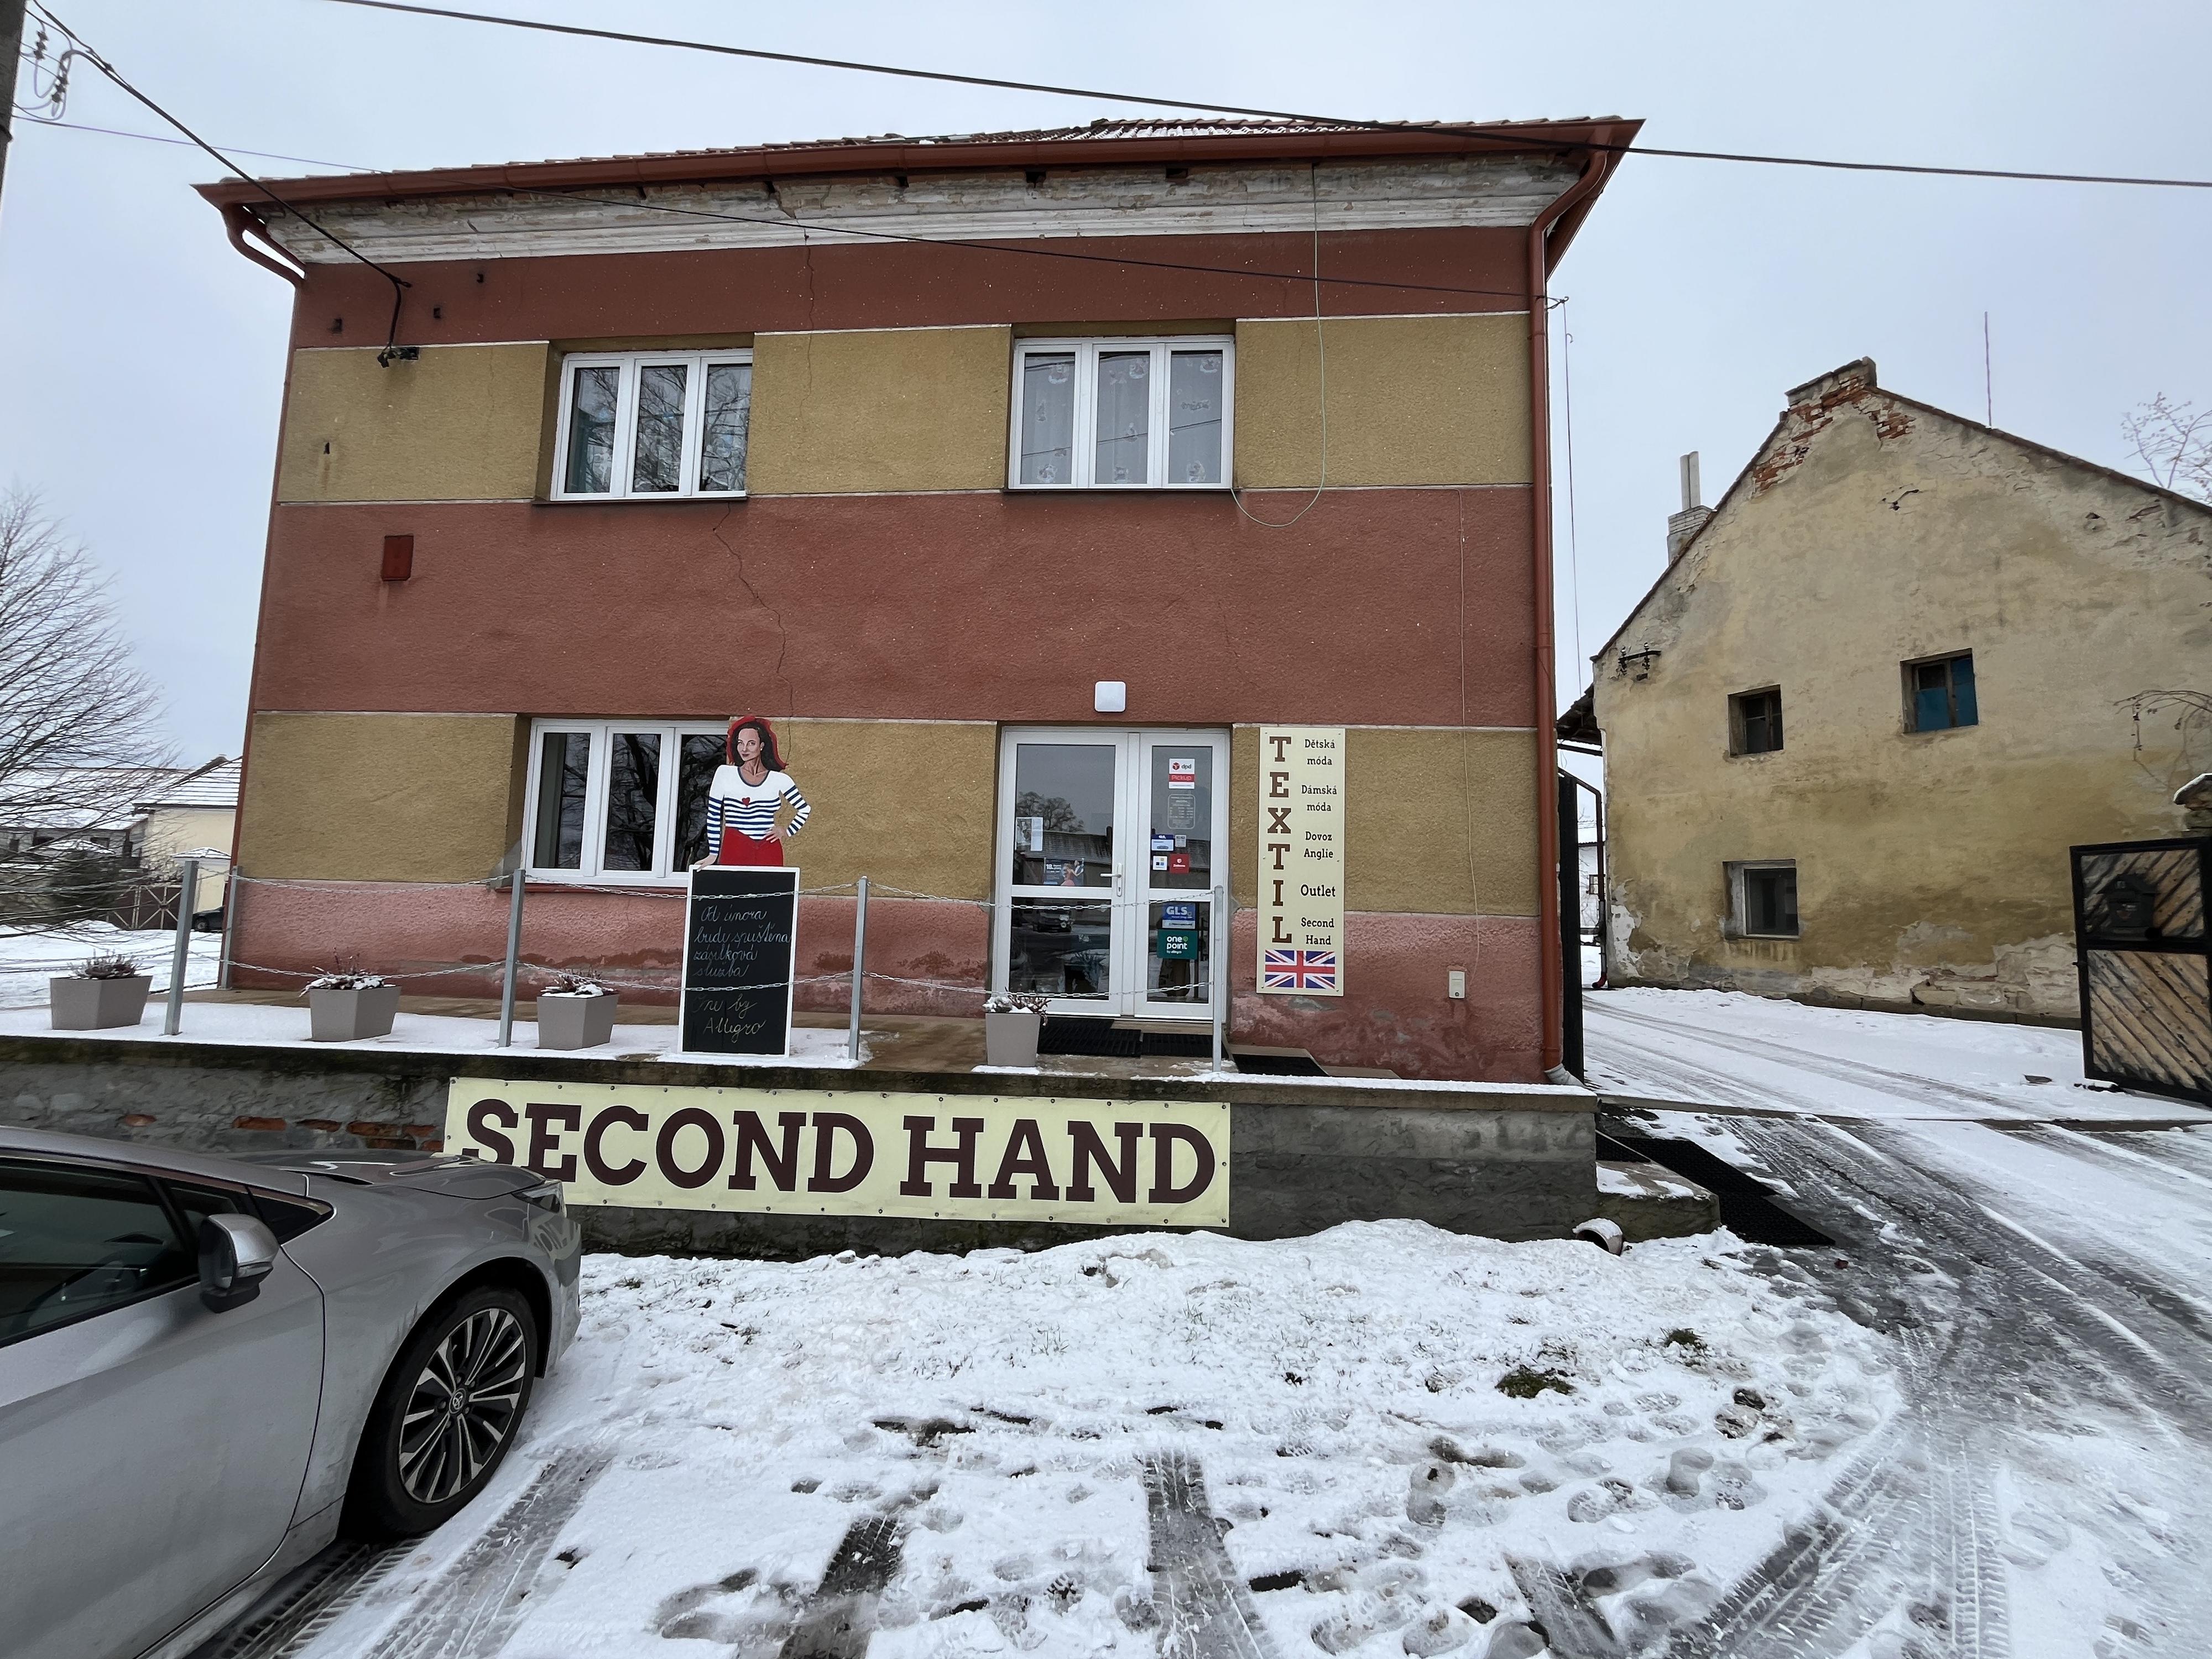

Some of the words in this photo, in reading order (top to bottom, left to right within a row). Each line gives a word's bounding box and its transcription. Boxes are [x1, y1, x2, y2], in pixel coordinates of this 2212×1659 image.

[1305, 739, 1335, 749] Dětská
[1307, 756, 1333, 765] móda
[1301, 785, 1338, 795] Dámská
[1307, 802, 1332, 811] móda
[1267, 736, 1292, 943] TEXTIL
[1305, 831, 1333, 841] Dovoz
[1303, 848, 1334, 860] Anglie
[1300, 884, 1336, 897] Outlet
[701, 905, 721, 922] Od
[1166, 906, 1188, 915] GLS
[1301, 917, 1335, 928] Second
[1306, 935, 1332, 945] Hand
[702, 1016, 767, 1044] Allegro
[462, 1098, 874, 1193] SECOND
[900, 1115, 1215, 1204] HAND
